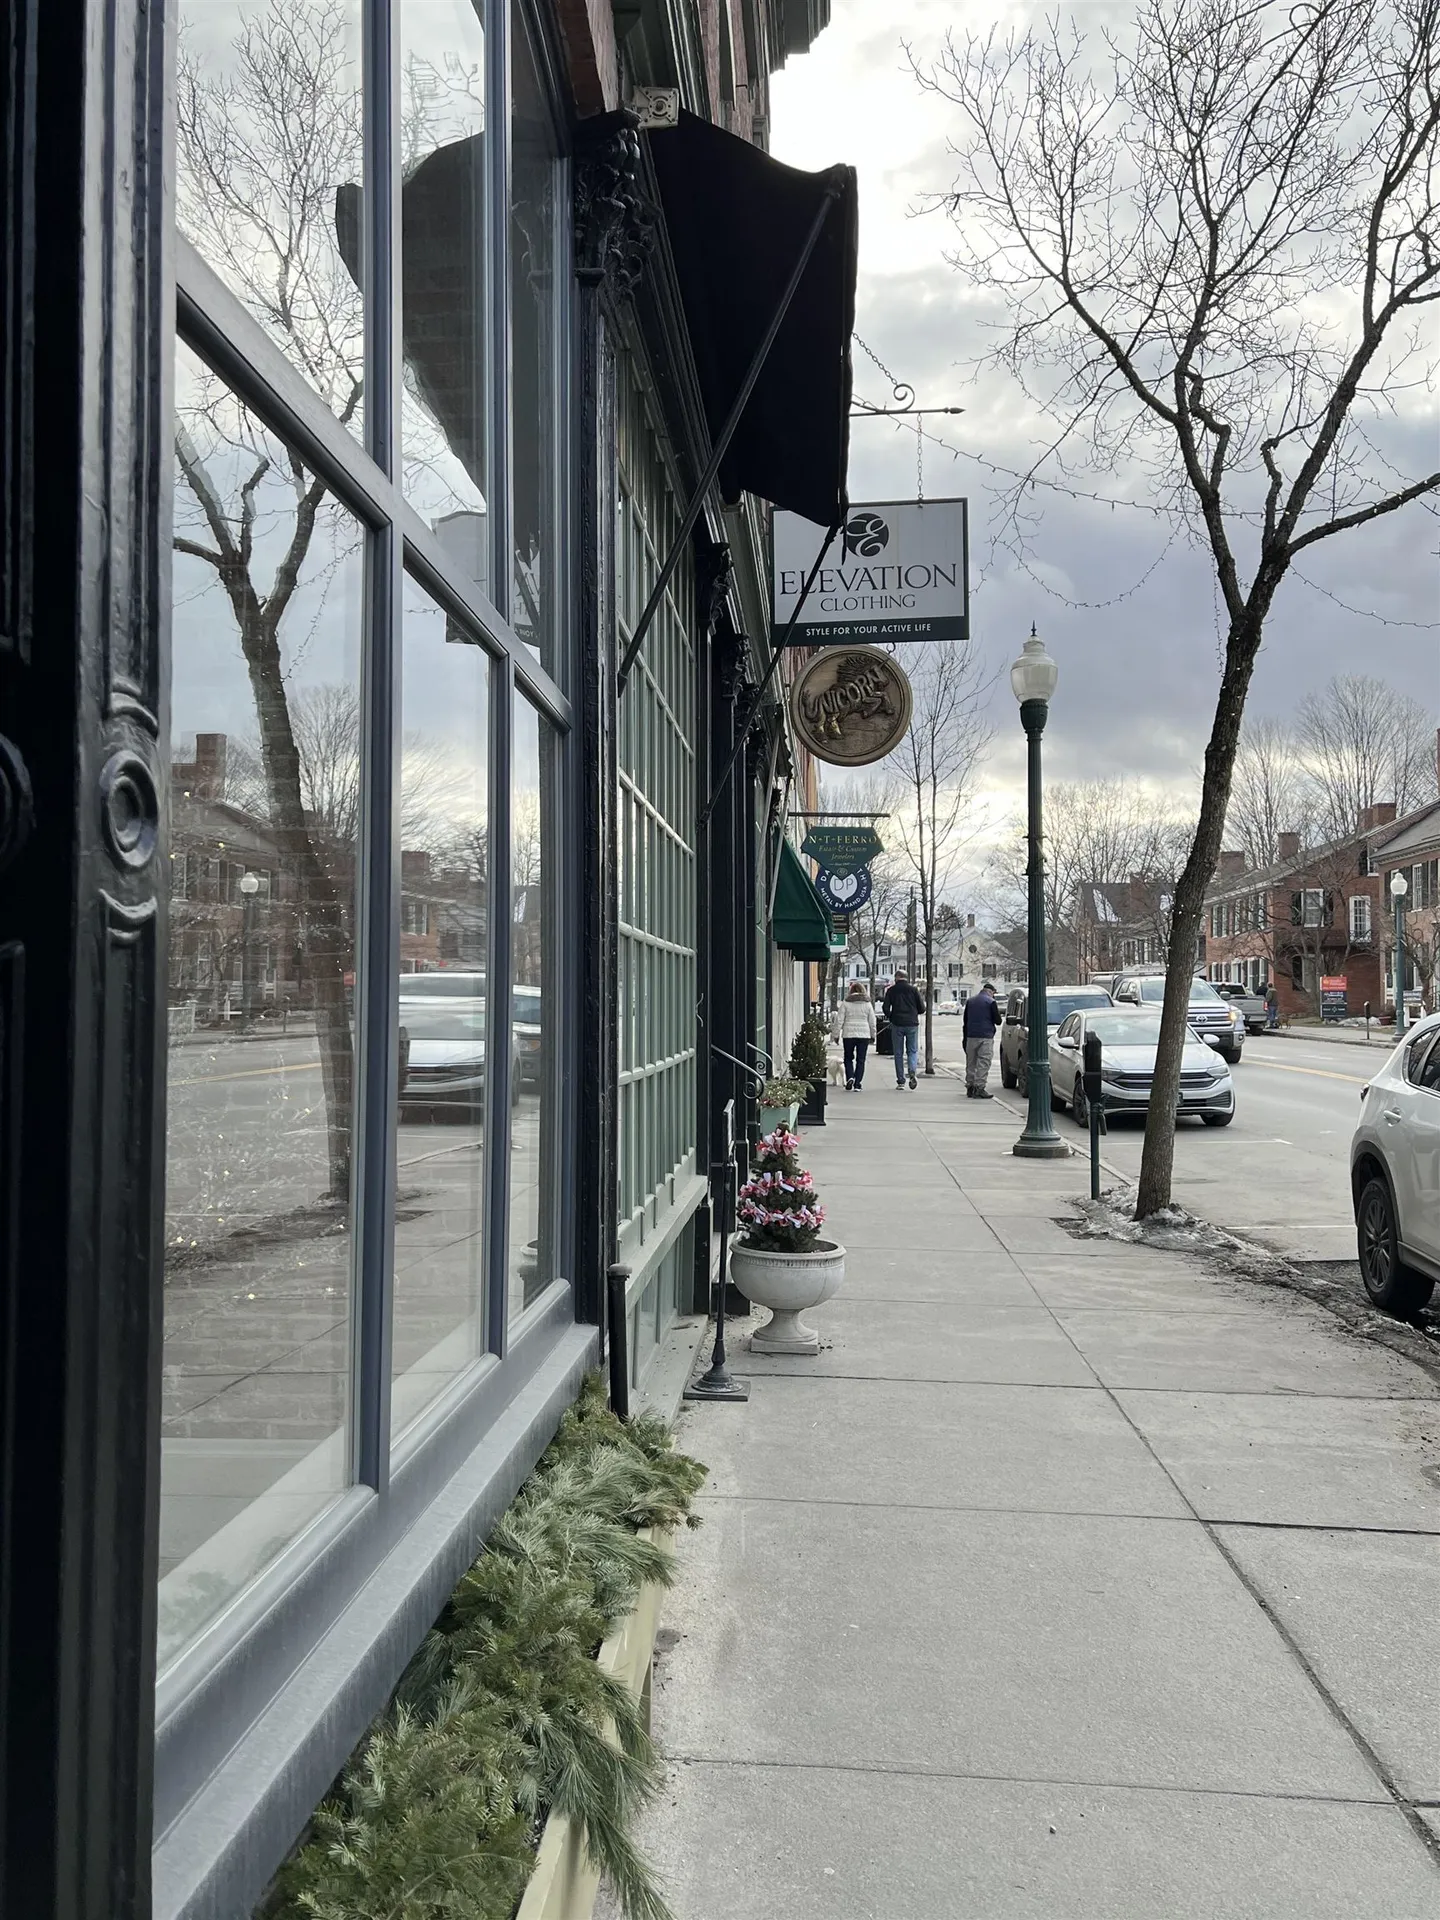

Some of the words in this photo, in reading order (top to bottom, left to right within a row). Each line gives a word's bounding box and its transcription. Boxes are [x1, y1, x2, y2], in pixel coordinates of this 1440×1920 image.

[780, 563, 957, 595] ELEVATION
[820, 594, 916, 612] CLOTHING
[806, 628, 830, 637] STYLE
[833, 627, 850, 635] FOR
[854, 625, 878, 634] YOUR
[881, 624, 911, 633] ACTIVE
[915, 623, 931, 632] LIFE
[803, 664, 887, 720] UNICORN
[821, 887, 833, 905] METAL
[844, 897, 861, 908] HAND
